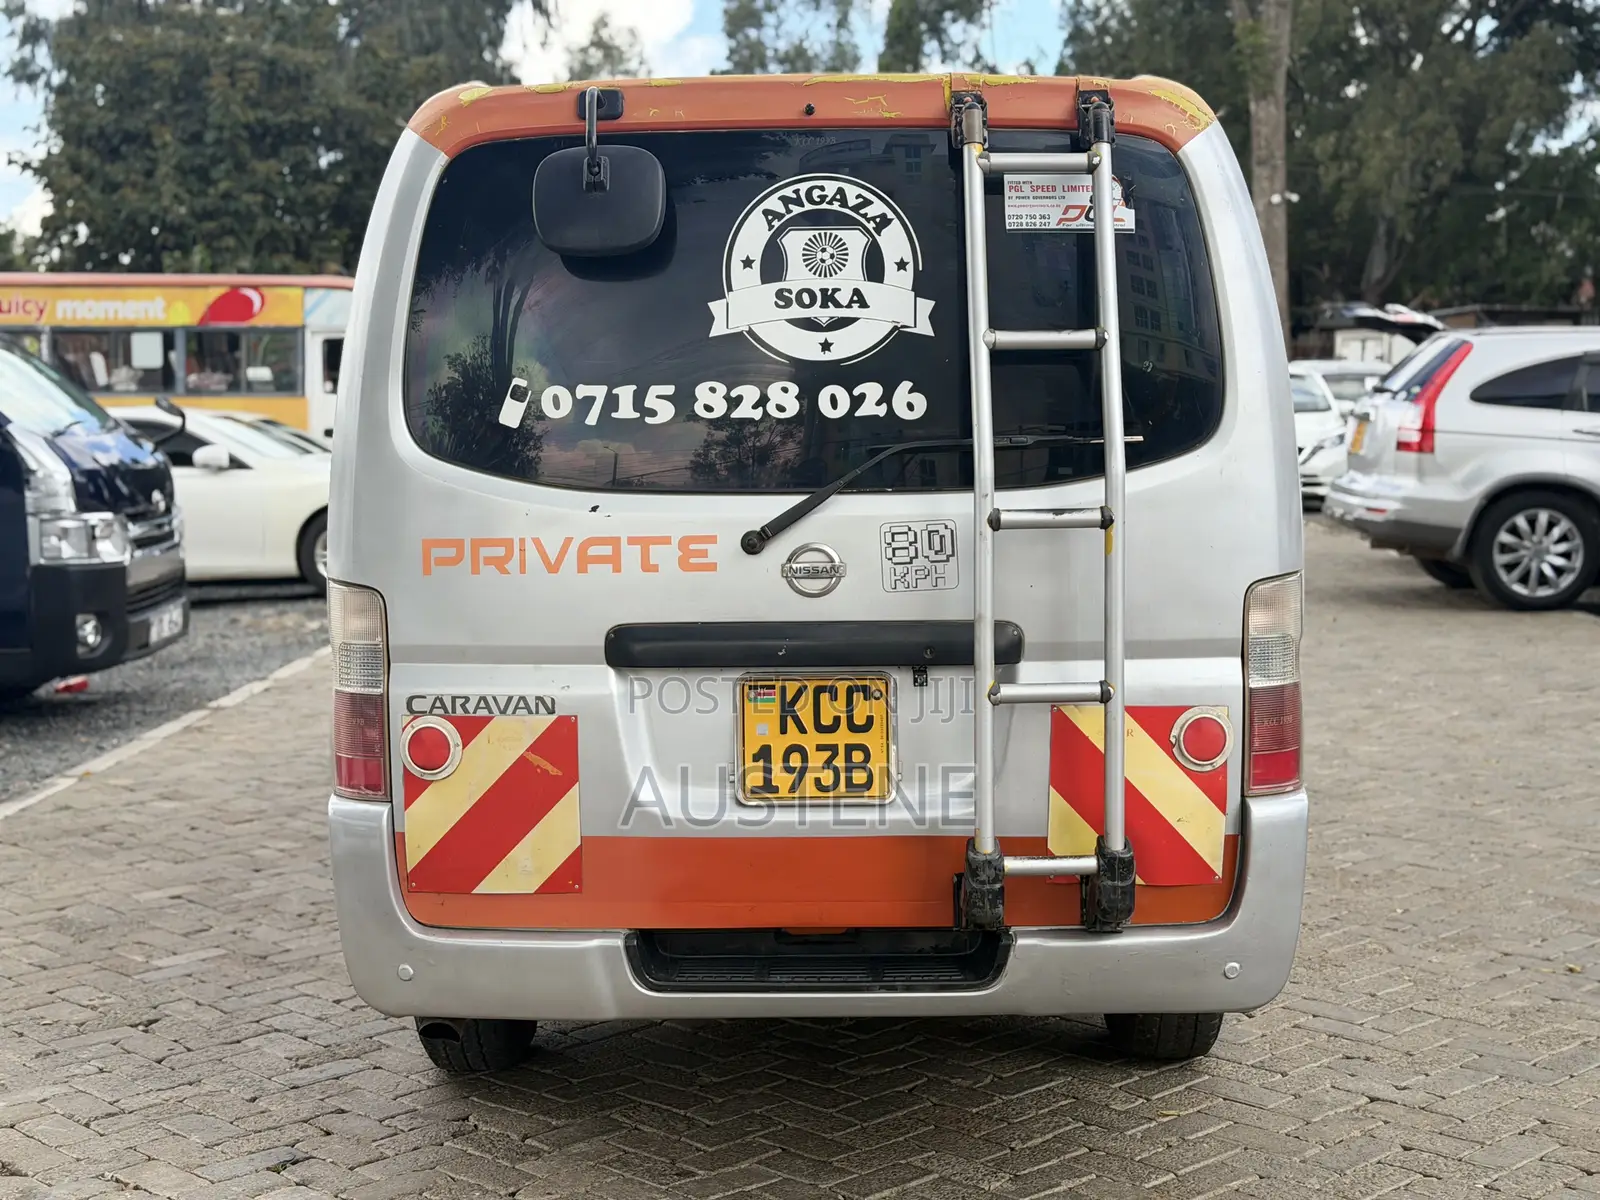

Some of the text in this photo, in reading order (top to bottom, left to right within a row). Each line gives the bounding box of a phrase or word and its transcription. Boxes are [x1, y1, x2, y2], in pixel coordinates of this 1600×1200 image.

[1008, 184, 1025, 193] PGL
[1029, 184, 1057, 193] SPEED
[761, 184, 895, 237] ANGAZA
[0, 294, 166, 322] uicy moment
[773, 287, 871, 310] SOKA
[540, 380, 928, 426] 0715 828 026
[421, 534, 719, 576] PRIVATE
[883, 523, 956, 565] 80
[788, 565, 840, 575] NISSAN
[889, 564, 949, 590] KPH
[405, 694, 557, 715] CARAVAN
[779, 684, 875, 735] KCC
[750, 742, 875, 794] 193B
